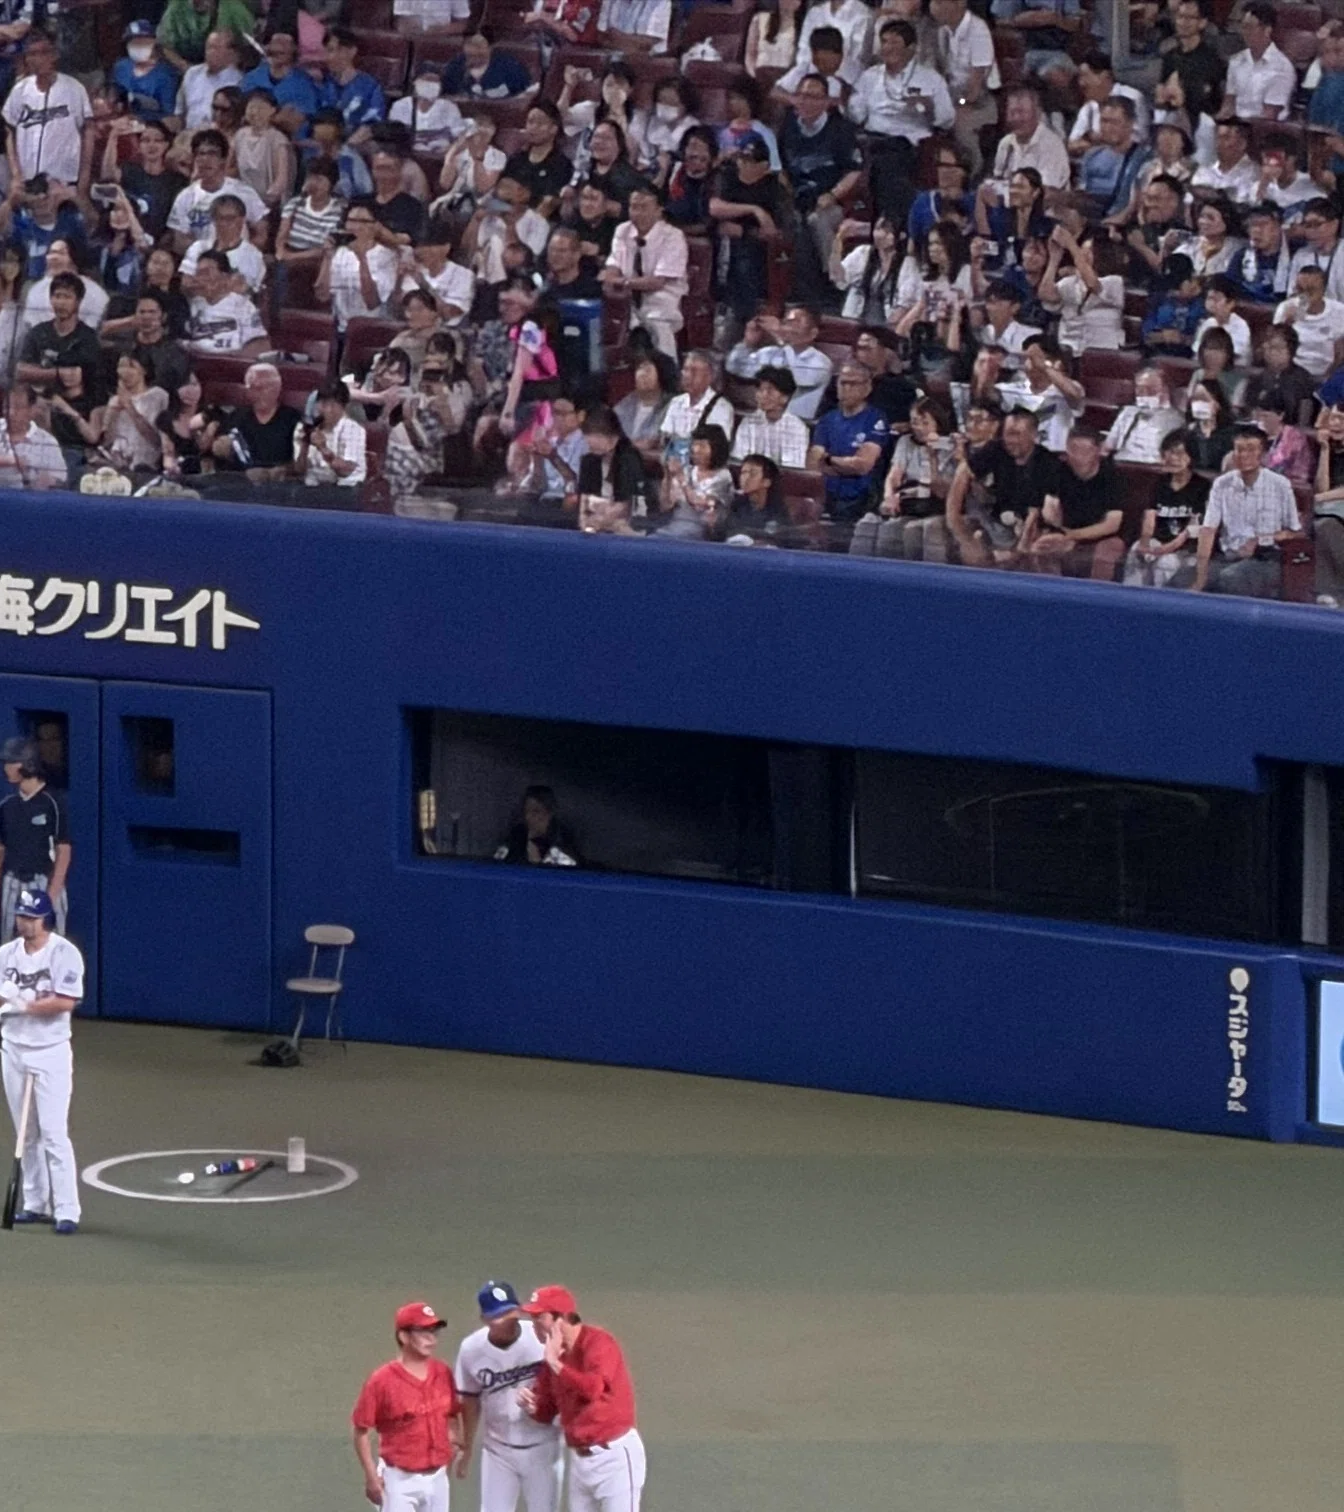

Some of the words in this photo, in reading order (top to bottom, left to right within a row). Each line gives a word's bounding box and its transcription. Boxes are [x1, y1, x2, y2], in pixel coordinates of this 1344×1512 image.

[1227, 994, 1249, 1098] スジャータ
